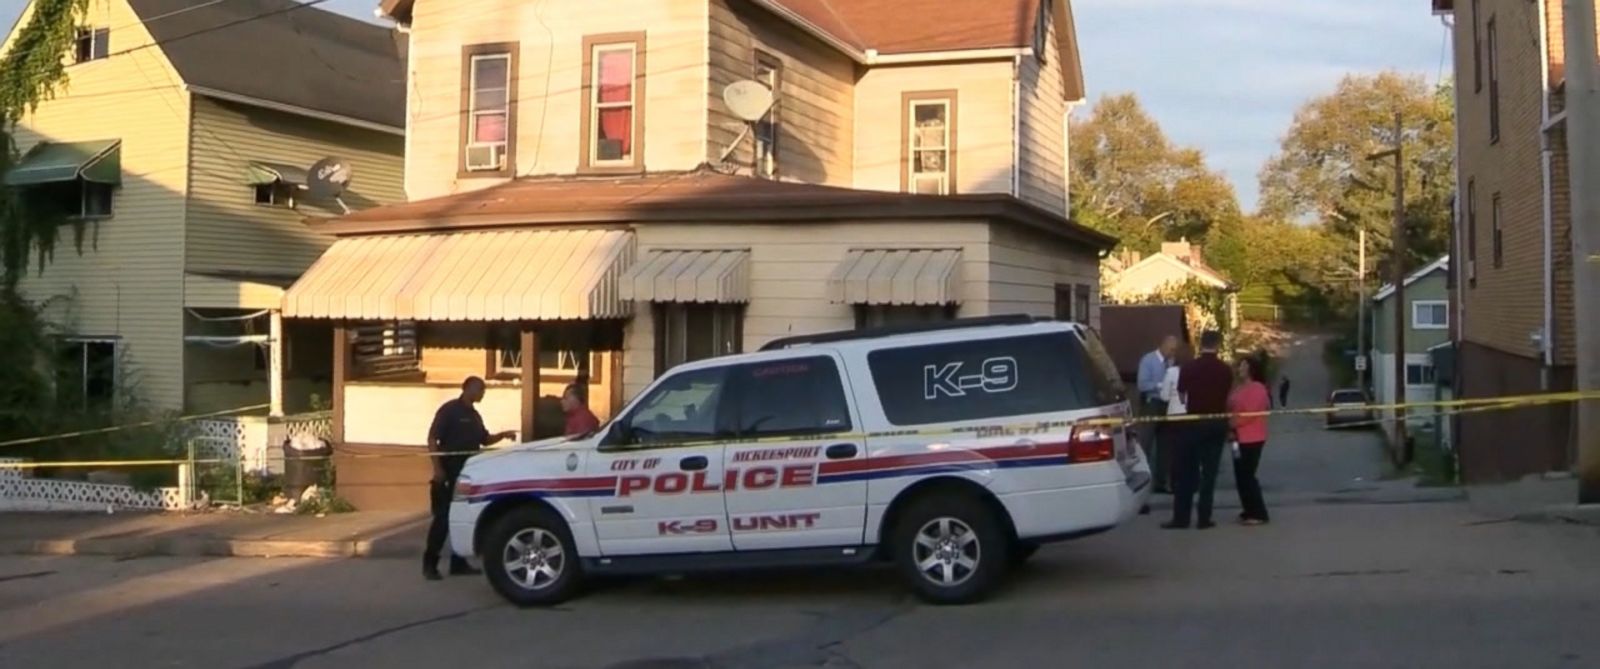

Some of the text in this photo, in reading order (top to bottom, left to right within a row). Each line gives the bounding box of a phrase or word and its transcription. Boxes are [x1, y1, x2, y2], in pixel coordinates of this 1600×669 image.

[924, 357, 1017, 399] K-9
[610, 457, 662, 471] CITY OF
[732, 445, 823, 462] MCKEESPORT
[618, 463, 816, 498] POLICE
[658, 513, 820, 535] K-9 UNIT
